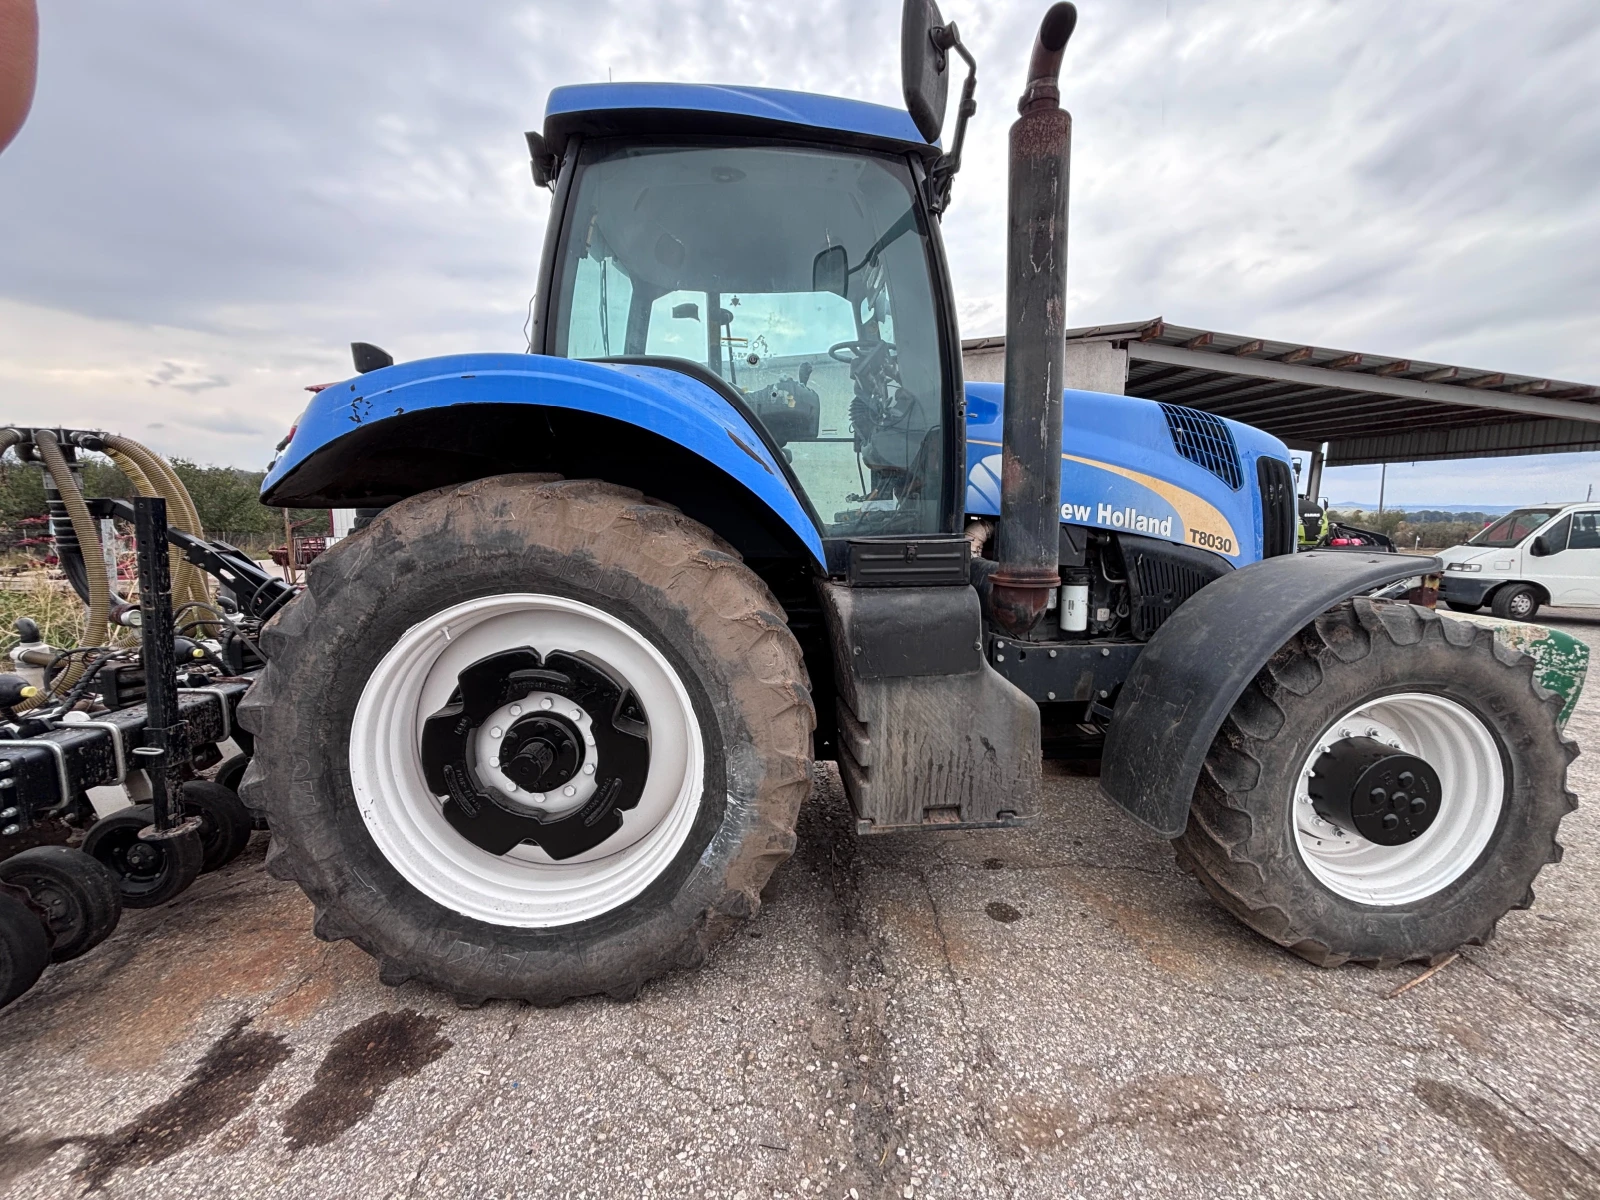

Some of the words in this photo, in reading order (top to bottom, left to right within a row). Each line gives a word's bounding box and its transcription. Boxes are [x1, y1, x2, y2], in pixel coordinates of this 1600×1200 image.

[1060, 502, 1091, 522] ew
[1097, 502, 1173, 537] Holland
[1189, 528, 1232, 553] T8030
